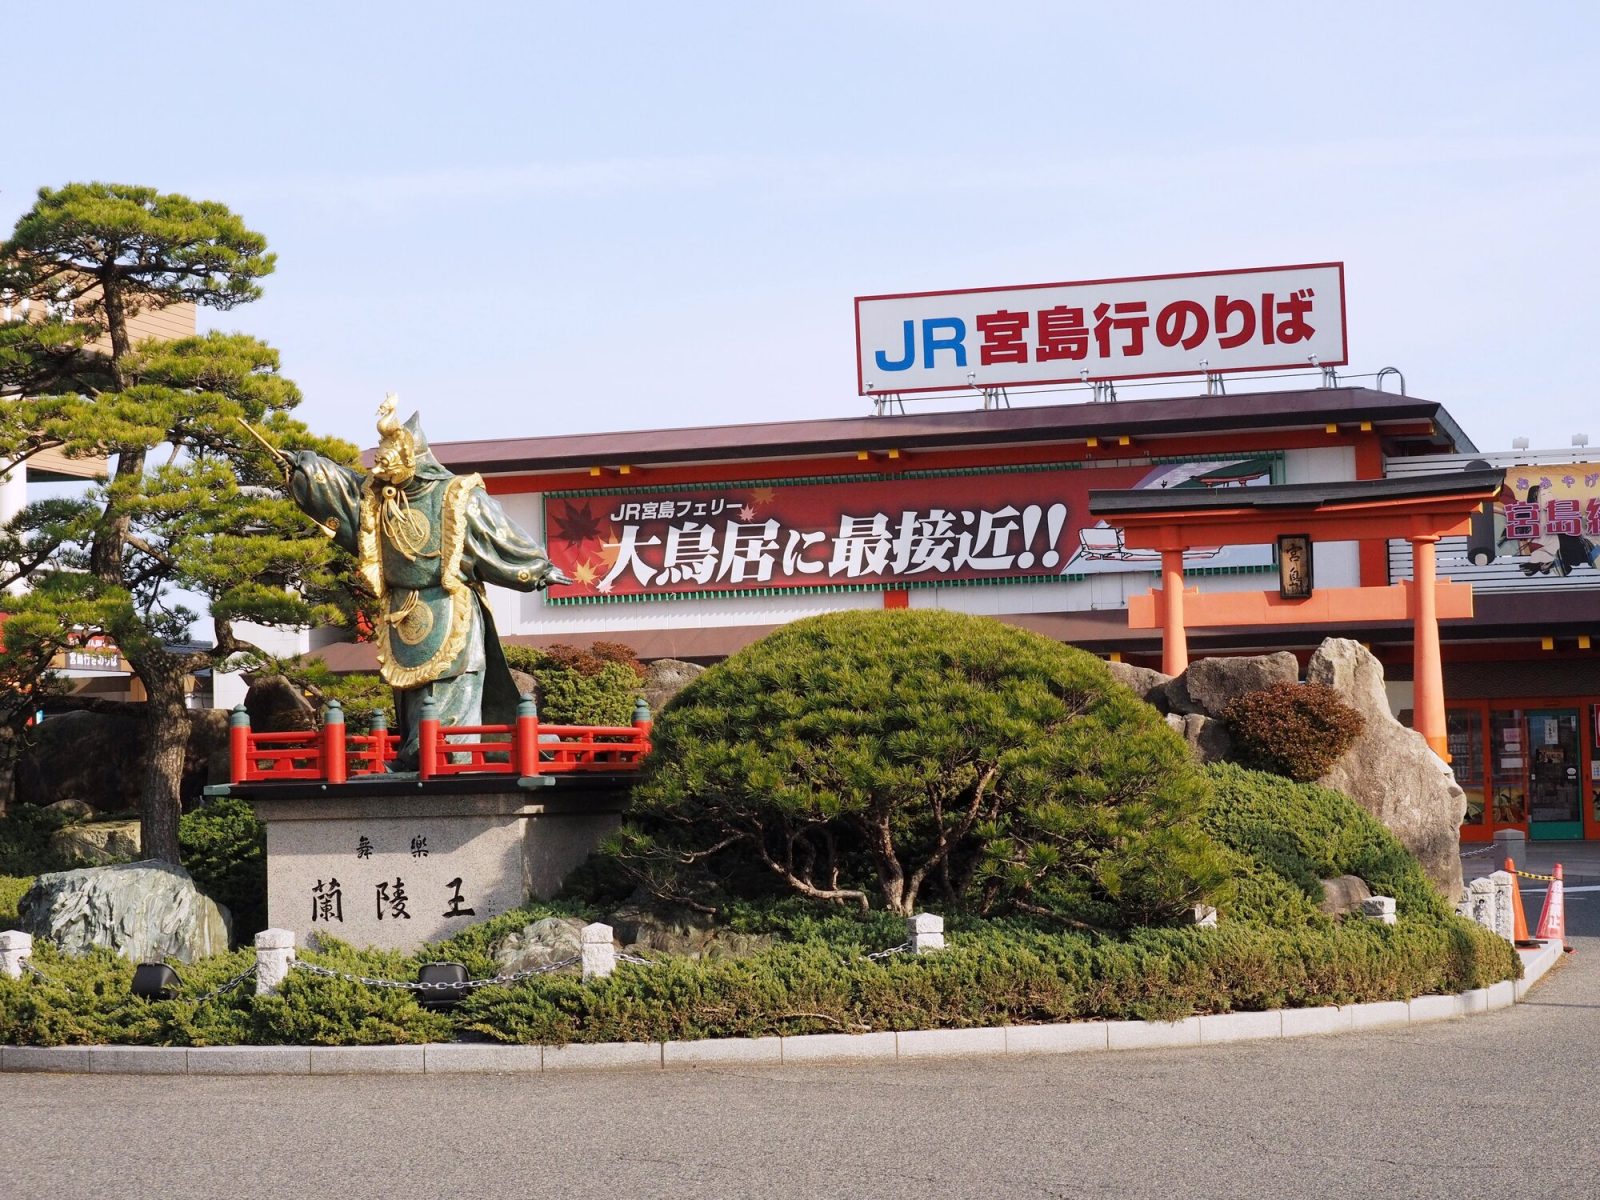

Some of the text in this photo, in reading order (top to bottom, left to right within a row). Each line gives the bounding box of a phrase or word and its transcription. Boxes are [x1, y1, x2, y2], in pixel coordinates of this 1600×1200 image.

[875, 287, 1316, 372] JR宮島行のりば
[610, 499, 743, 522] JR宮島フェリー
